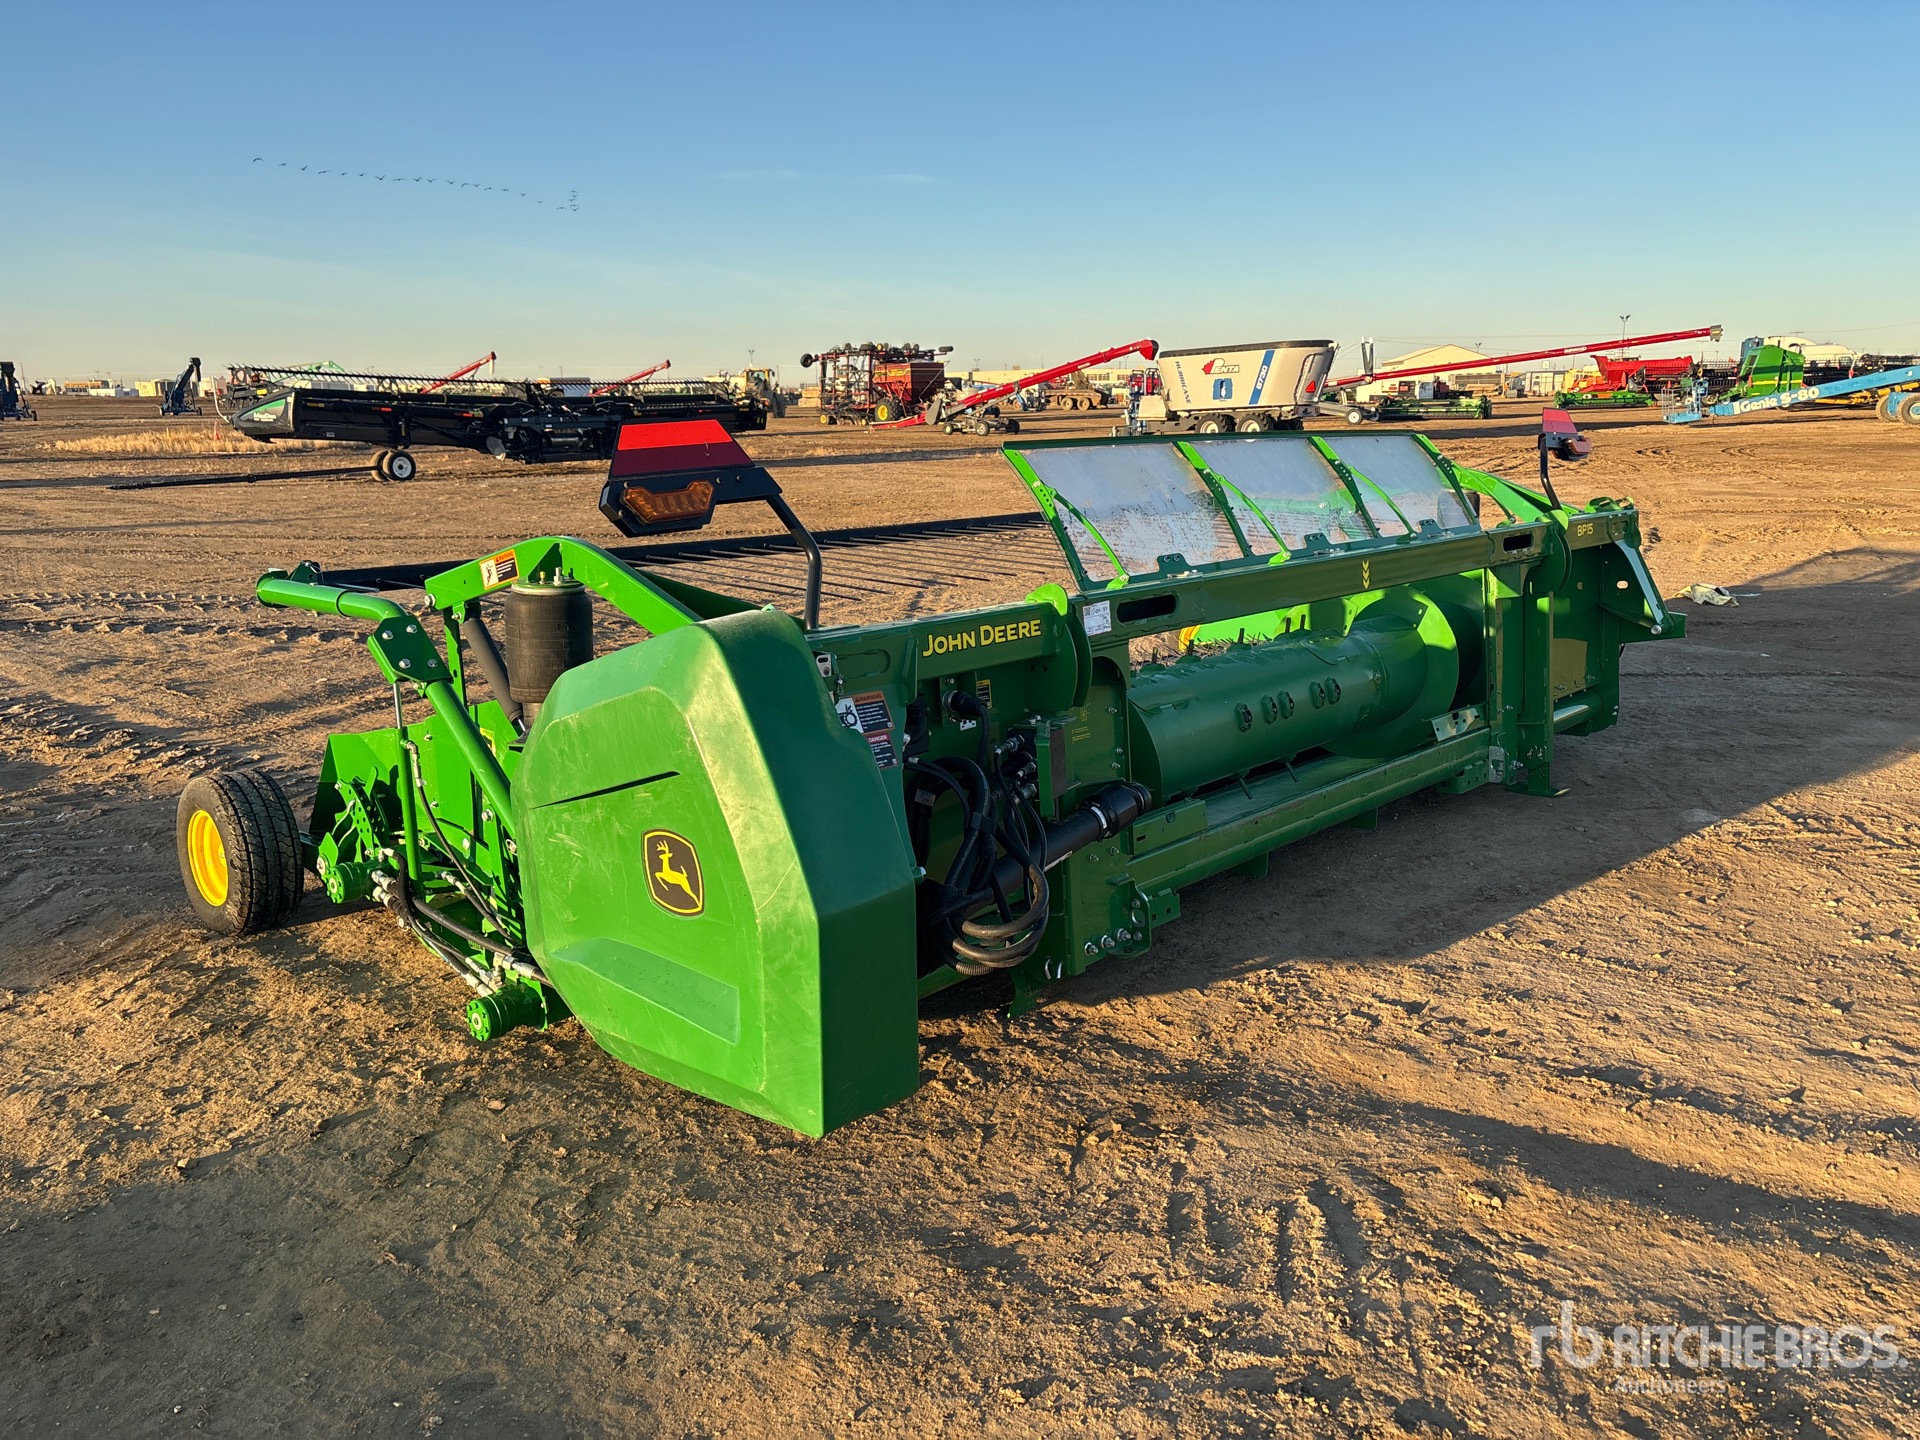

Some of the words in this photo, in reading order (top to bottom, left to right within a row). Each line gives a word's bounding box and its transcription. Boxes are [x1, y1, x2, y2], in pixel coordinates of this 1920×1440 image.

[1210, 358, 1240, 374] PENTA
[1175, 361, 1191, 404] HURRICANE
[1740, 397, 1778, 413] Genie
[1780, 387, 1819, 405] S-80
[1577, 522, 1593, 536] BP15
[922, 630, 976, 657] JOHN
[980, 619, 1042, 645] DEERE
[859, 693, 882, 703] WARNING
[868, 734, 888, 743] DANGER
